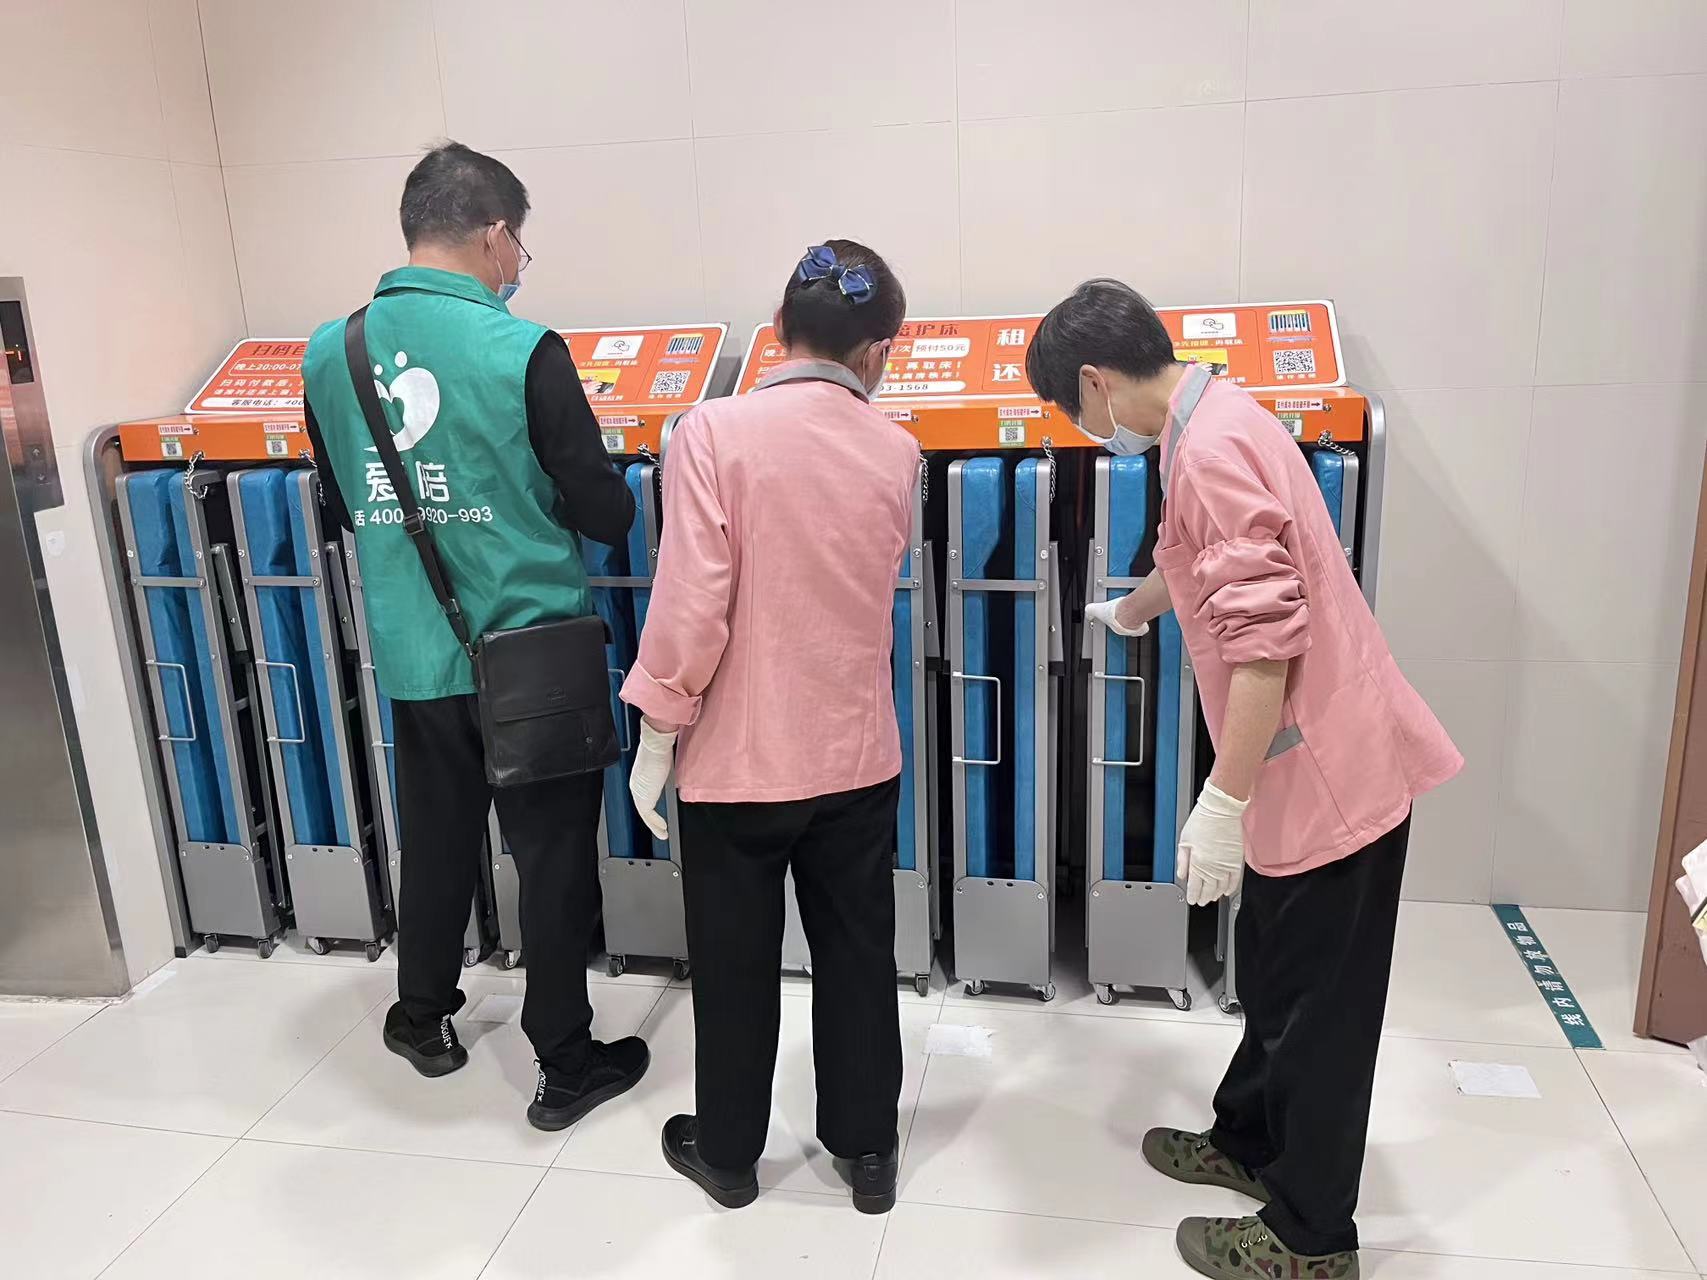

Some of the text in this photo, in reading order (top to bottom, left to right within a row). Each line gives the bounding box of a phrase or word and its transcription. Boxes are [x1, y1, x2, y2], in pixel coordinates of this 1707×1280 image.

[996, 328, 1025, 346] 租
[889, 344, 966, 353] /次 预付50元
[992, 363, 1022, 382] 还
[220, 379, 304, 387] 扫码付款后，
